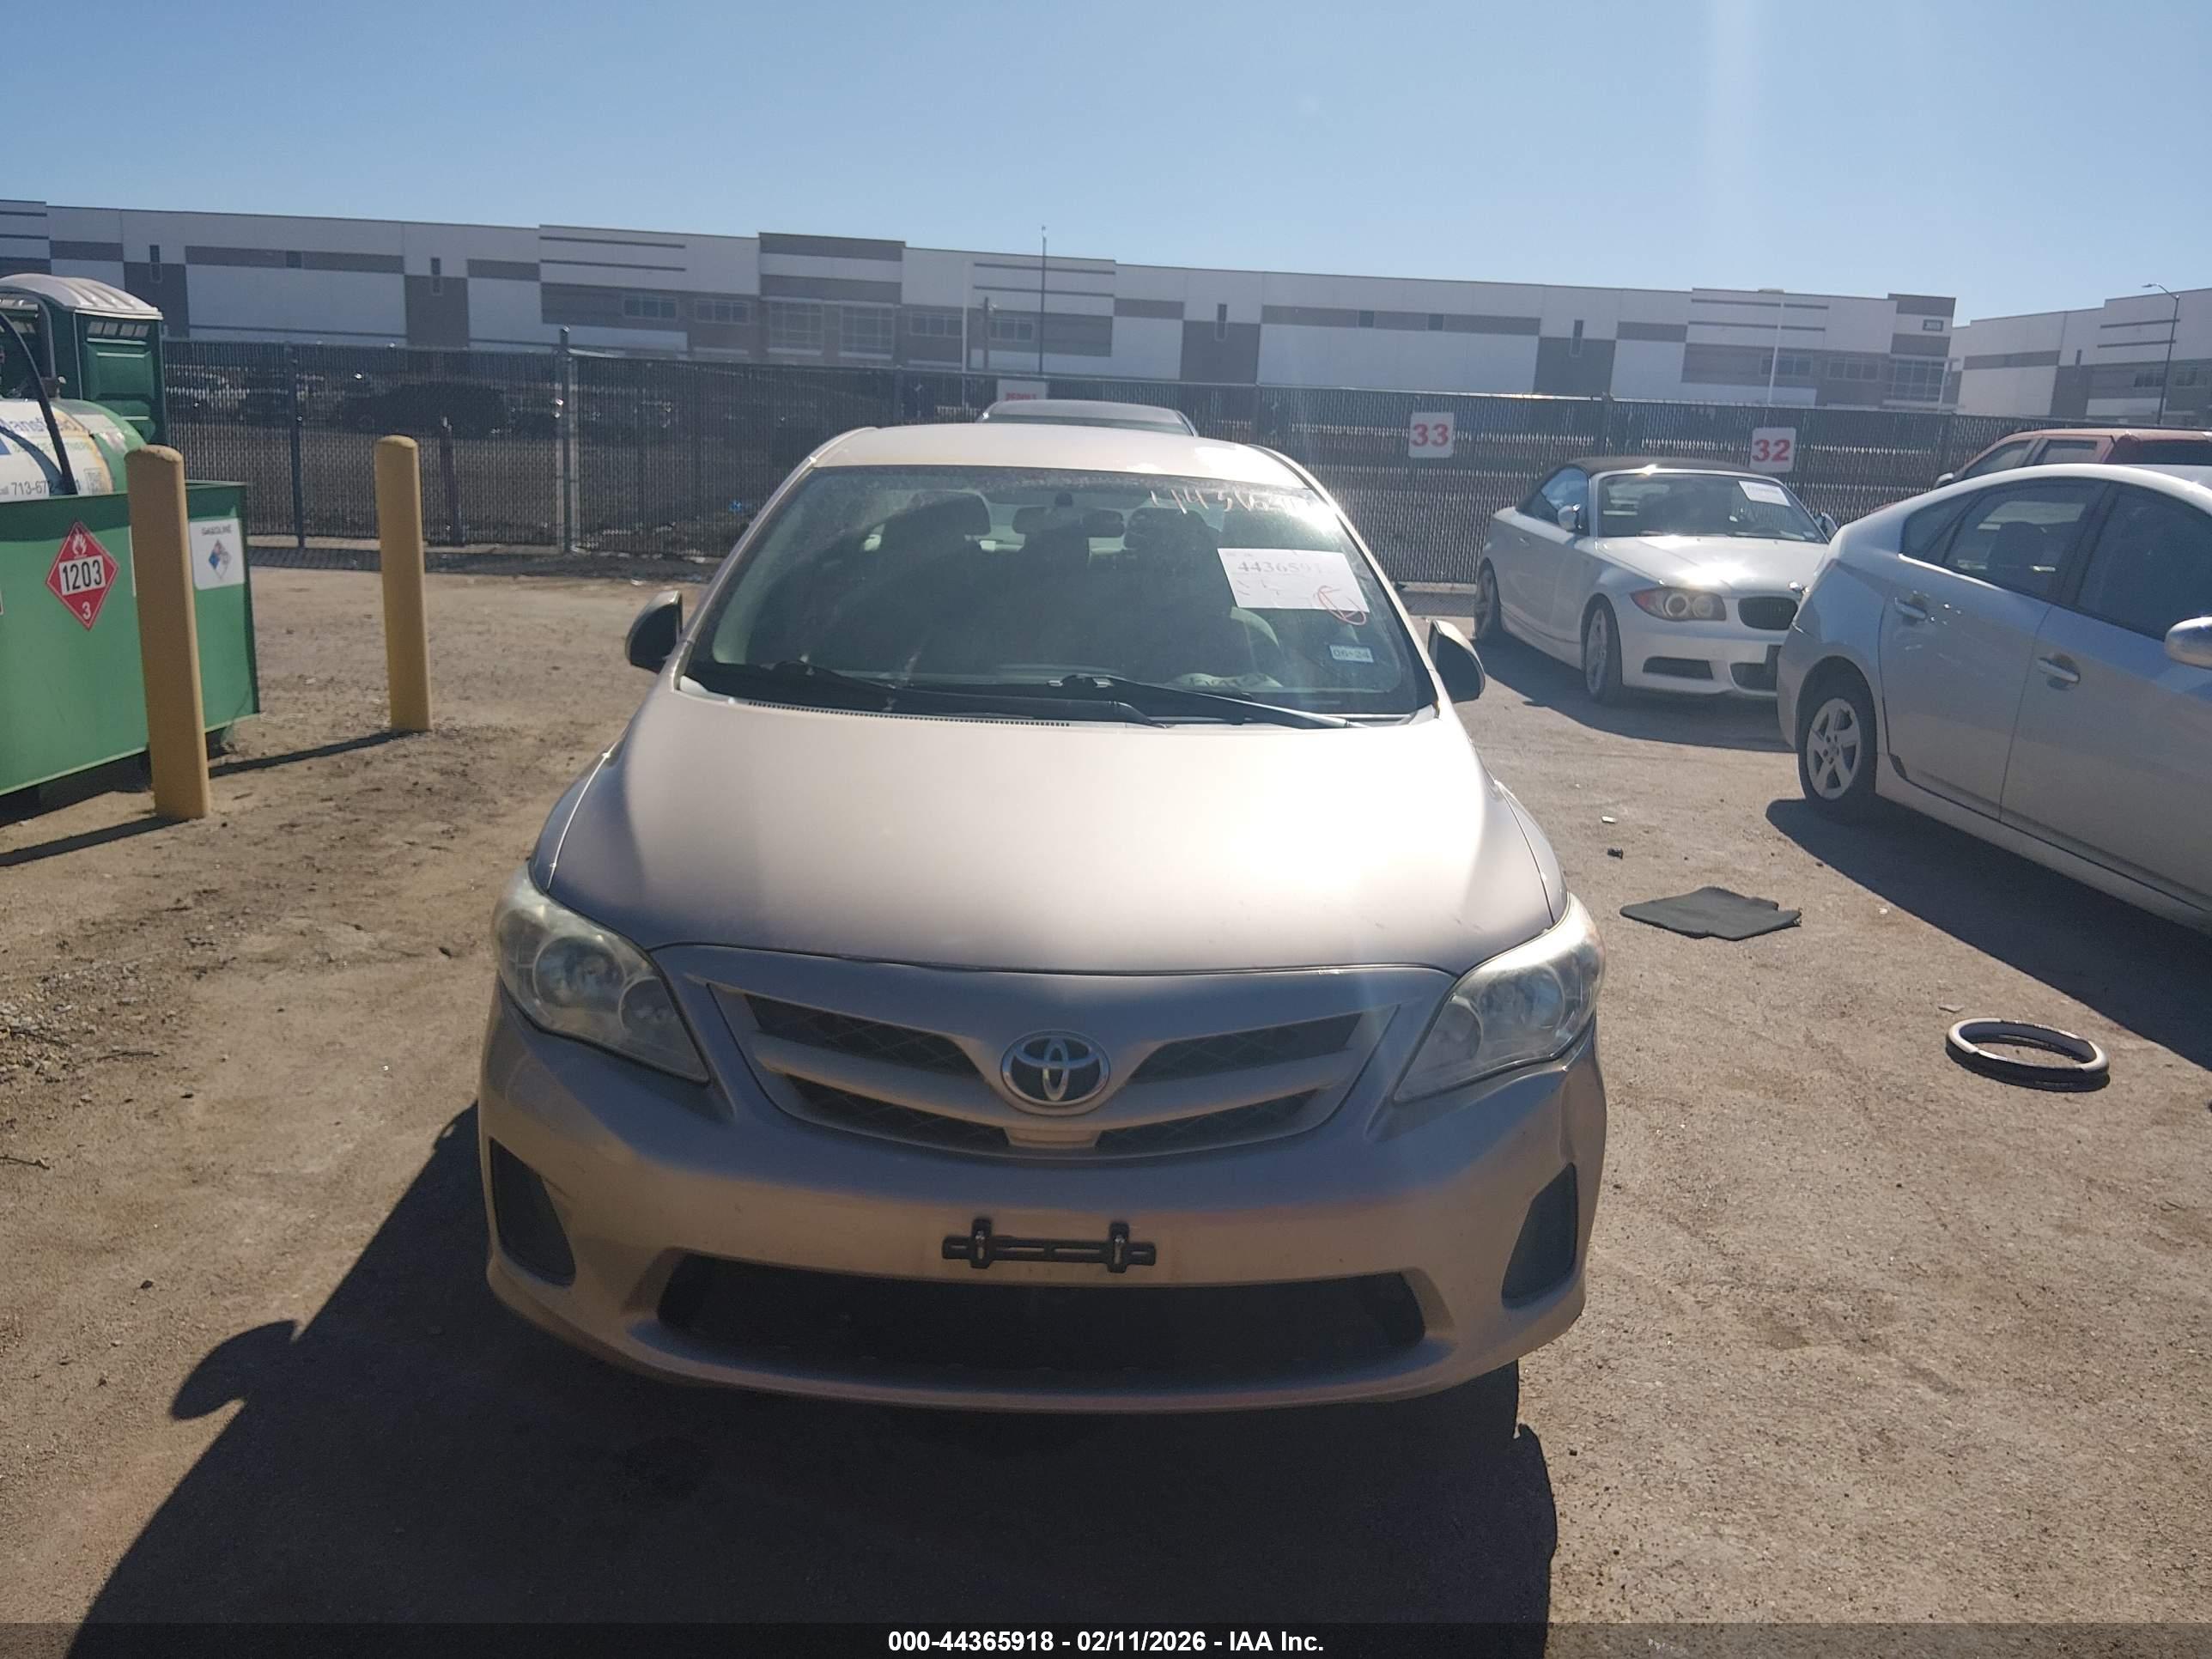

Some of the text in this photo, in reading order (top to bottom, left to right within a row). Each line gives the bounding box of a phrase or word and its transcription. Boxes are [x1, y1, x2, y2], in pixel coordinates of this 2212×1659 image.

[1411, 424, 1449, 447] 33
[1753, 439, 1790, 462] 32
[63, 559, 102, 592] 1203
[82, 601, 92, 620] 3
